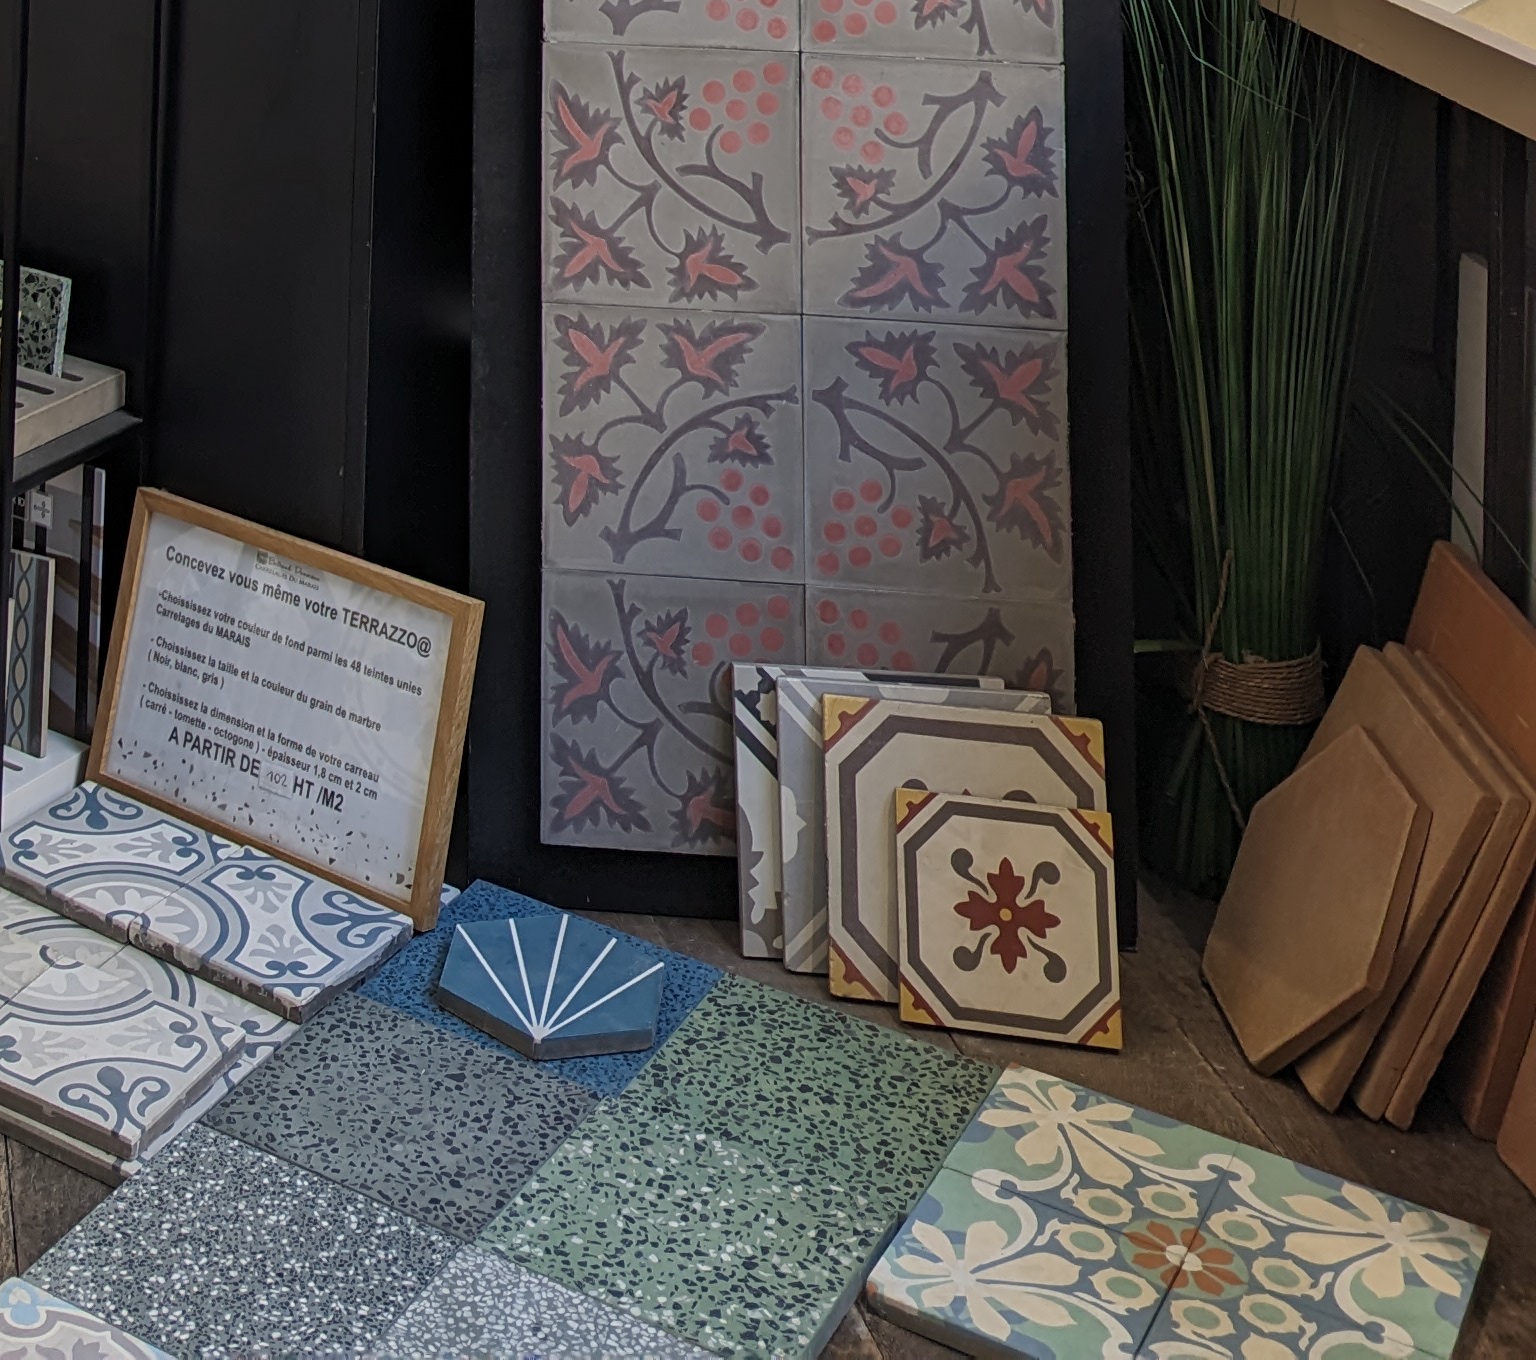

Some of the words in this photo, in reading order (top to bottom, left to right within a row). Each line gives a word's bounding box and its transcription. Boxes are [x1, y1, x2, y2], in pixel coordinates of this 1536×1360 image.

[165, 545, 226, 580] Concevez
[228, 570, 259, 592] vous
[262, 583, 301, 607] même
[304, 597, 338, 621] votre
[156, 603, 201, 629] Carrelages
[202, 621, 214, 633] du
[215, 625, 251, 648] MARAIS
[214, 610, 236, 626] votre
[237, 621, 270, 639] couleur
[272, 630, 283, 644] de
[284, 634, 306, 652] fond
[306, 645, 333, 662] parmi
[335, 654, 348, 668] les
[350, 660, 362, 673] 48
[363, 664, 395, 685] teintes
[396, 678, 423, 696] unies
[218, 660, 239, 676] taille
[261, 678, 295, 699] couleur
[296, 690, 308, 704] du
[309, 697, 333, 713] grain
[335, 705, 347, 719] de
[348, 711, 382, 732] marbre
[168, 725, 180, 746] A
[182, 730, 236, 769] PARTIR
[239, 753, 261, 779] DE
[292, 775, 315, 799] HT
[315, 785, 345, 813] /M2
[210, 706, 255, 733] dimension
[277, 732, 304, 753] forme
[305, 744, 317, 758] de
[319, 751, 342, 768] votre
[344, 761, 380, 783] carreau
[267, 745, 311, 773] épaisseur
[313, 764, 327, 780] 1,8
[328, 773, 342, 786] cm
[363, 787, 378, 801] cm
